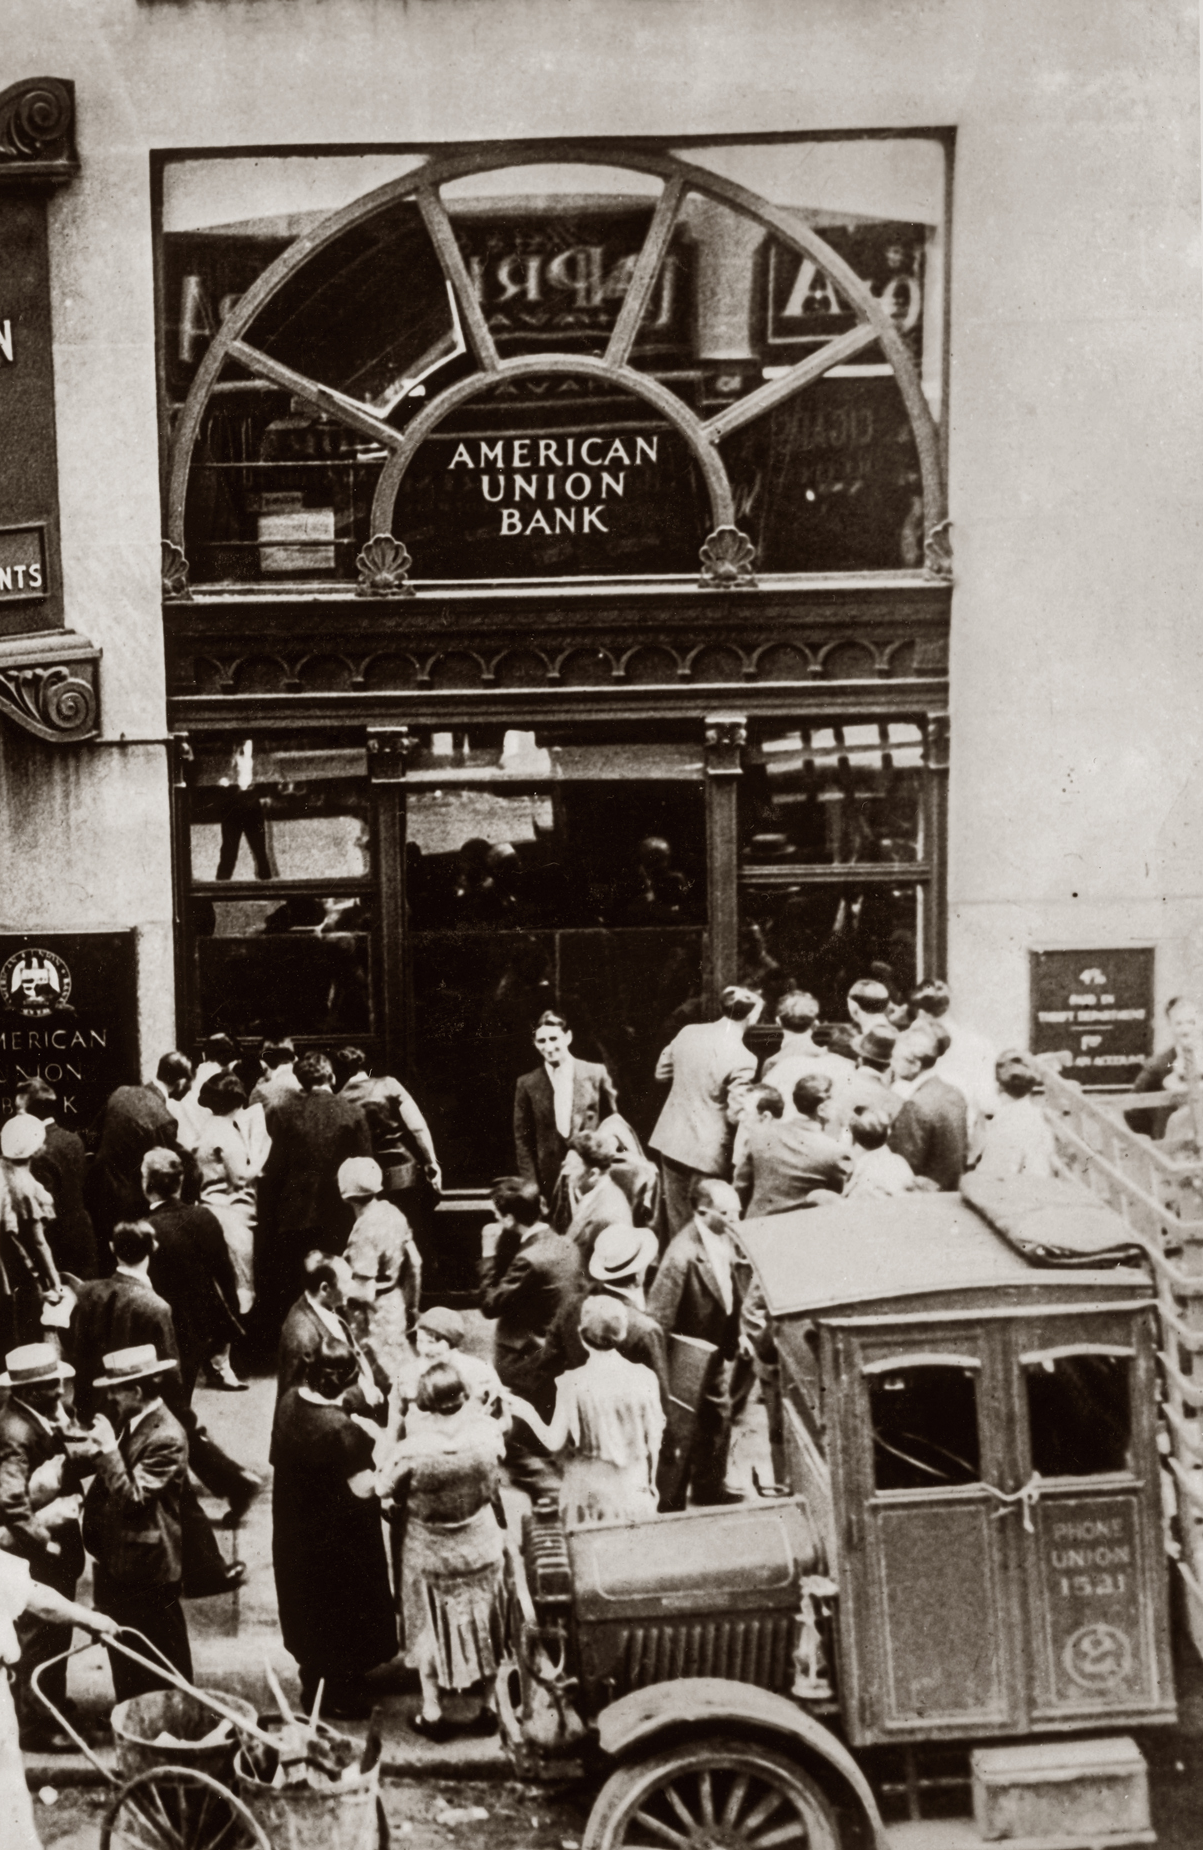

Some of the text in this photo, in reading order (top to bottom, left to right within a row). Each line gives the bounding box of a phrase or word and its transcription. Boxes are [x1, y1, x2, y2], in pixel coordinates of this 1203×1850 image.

[447, 436, 658, 469] AMERICAN
[480, 471, 626, 502] UNION
[499, 505, 610, 536] BANK
[2, 1096, 78, 1115] BK
[1053, 1518, 1124, 1541] PHONE
[1051, 1547, 1130, 1569] UNION
